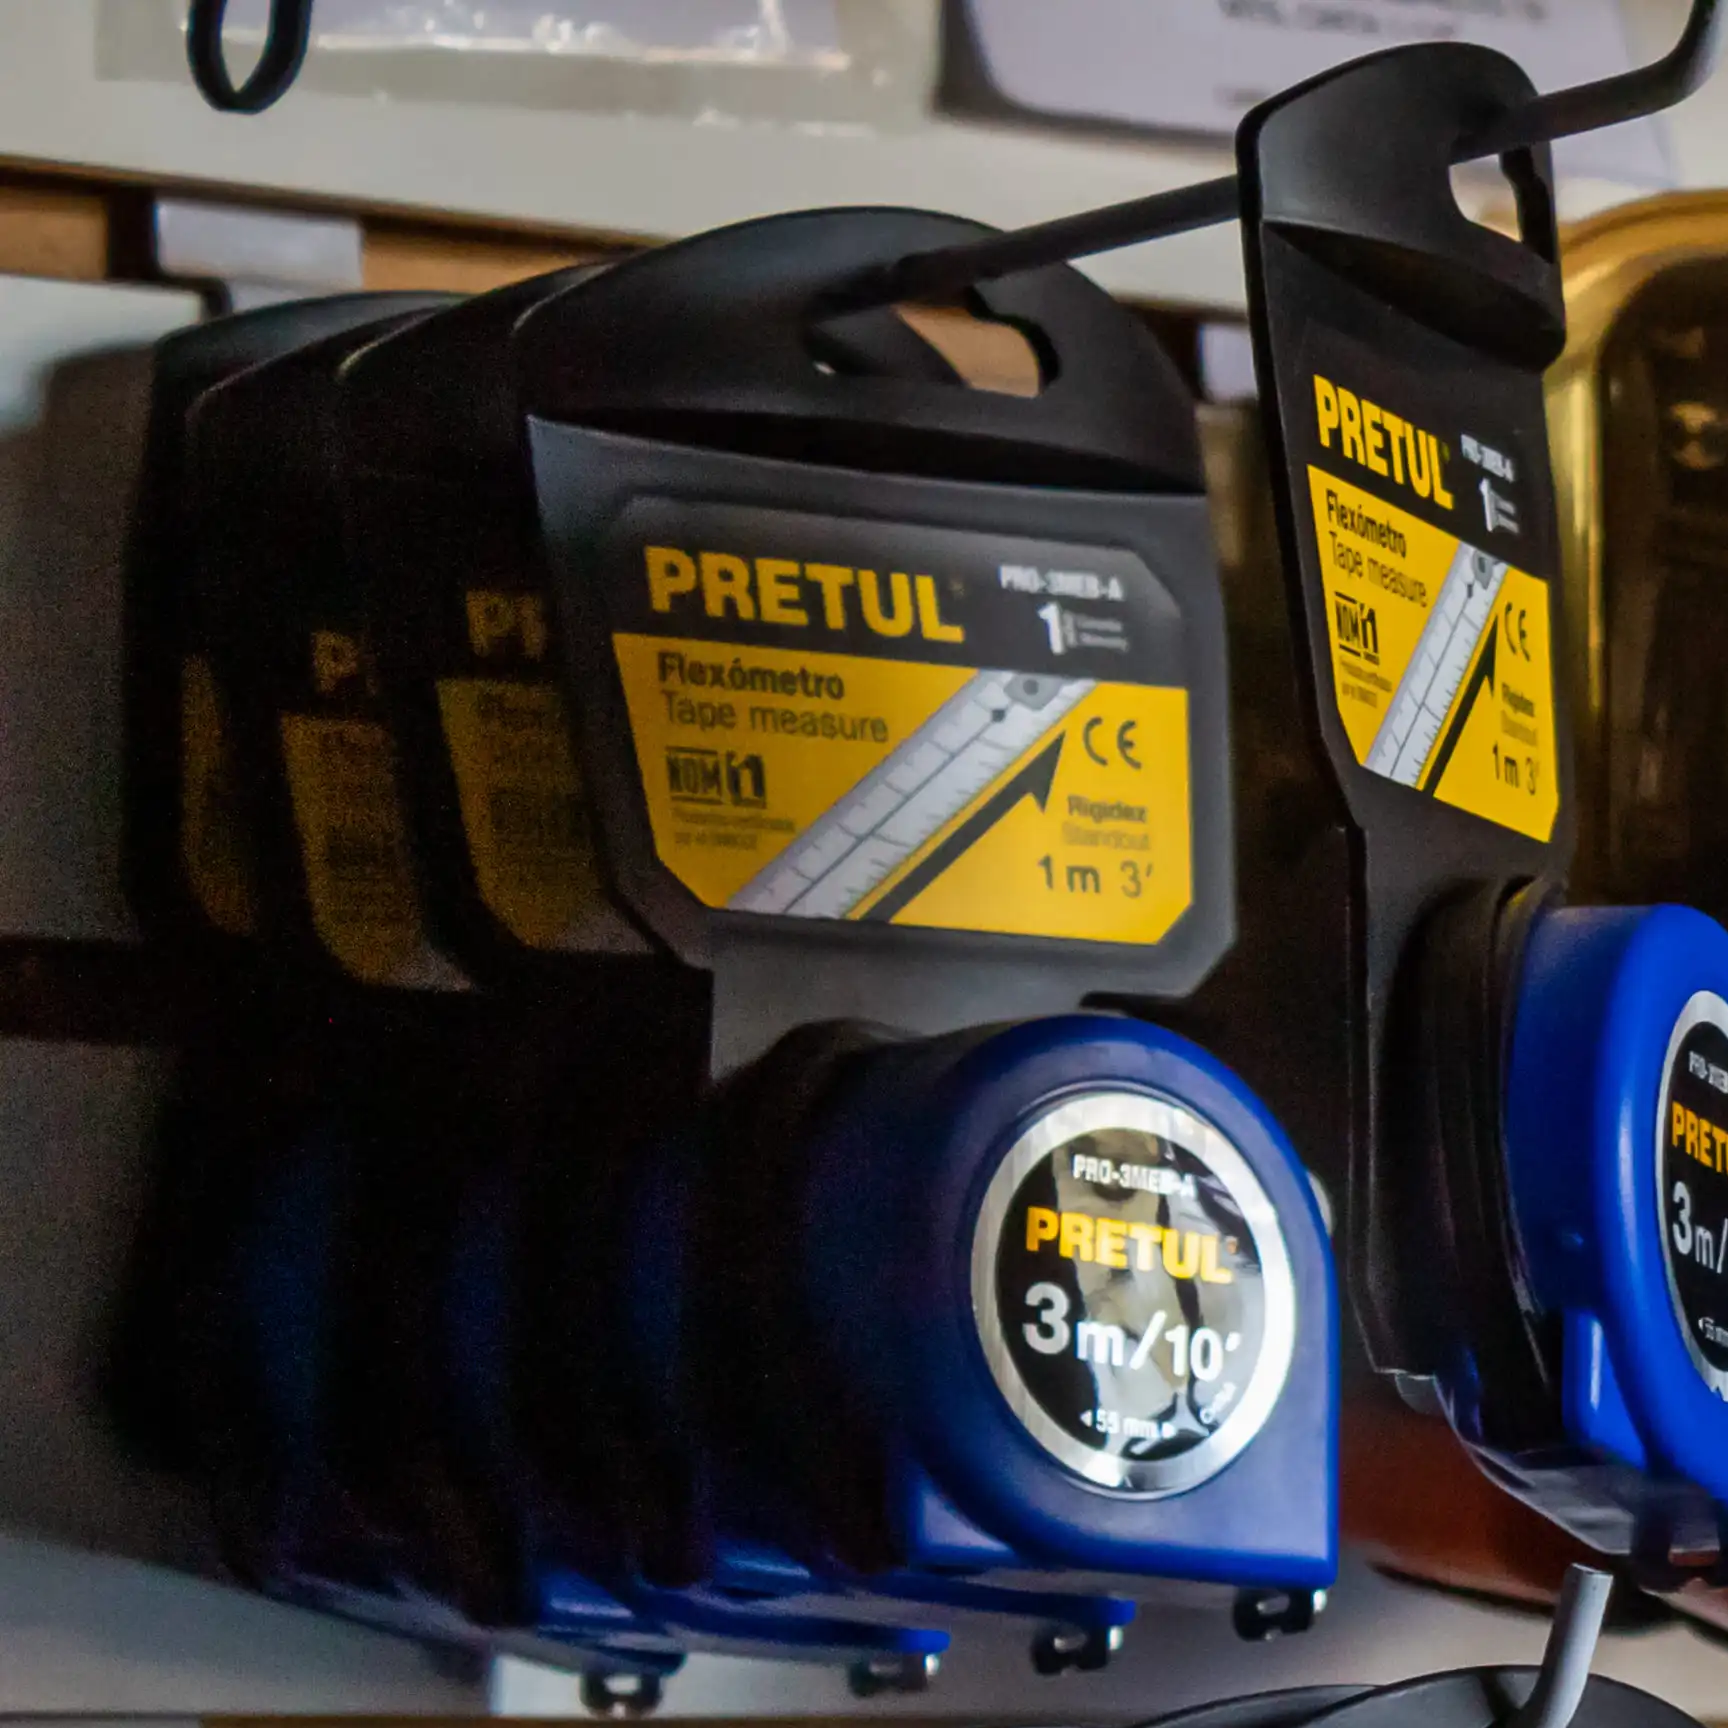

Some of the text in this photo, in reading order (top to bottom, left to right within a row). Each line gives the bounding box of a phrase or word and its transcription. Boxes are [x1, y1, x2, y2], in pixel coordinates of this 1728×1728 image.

[1313, 374, 1453, 510] PRETUL
[1326, 488, 1406, 558] Flexómetro
[643, 545, 964, 643] PRETUL
[1329, 531, 1428, 608] Tape measure
[1037, 602, 1064, 656] 1
[657, 651, 845, 700] Flexómetro
[664, 690, 889, 743] Tape measure
[1025, 1206, 1233, 1285] PRETUL
